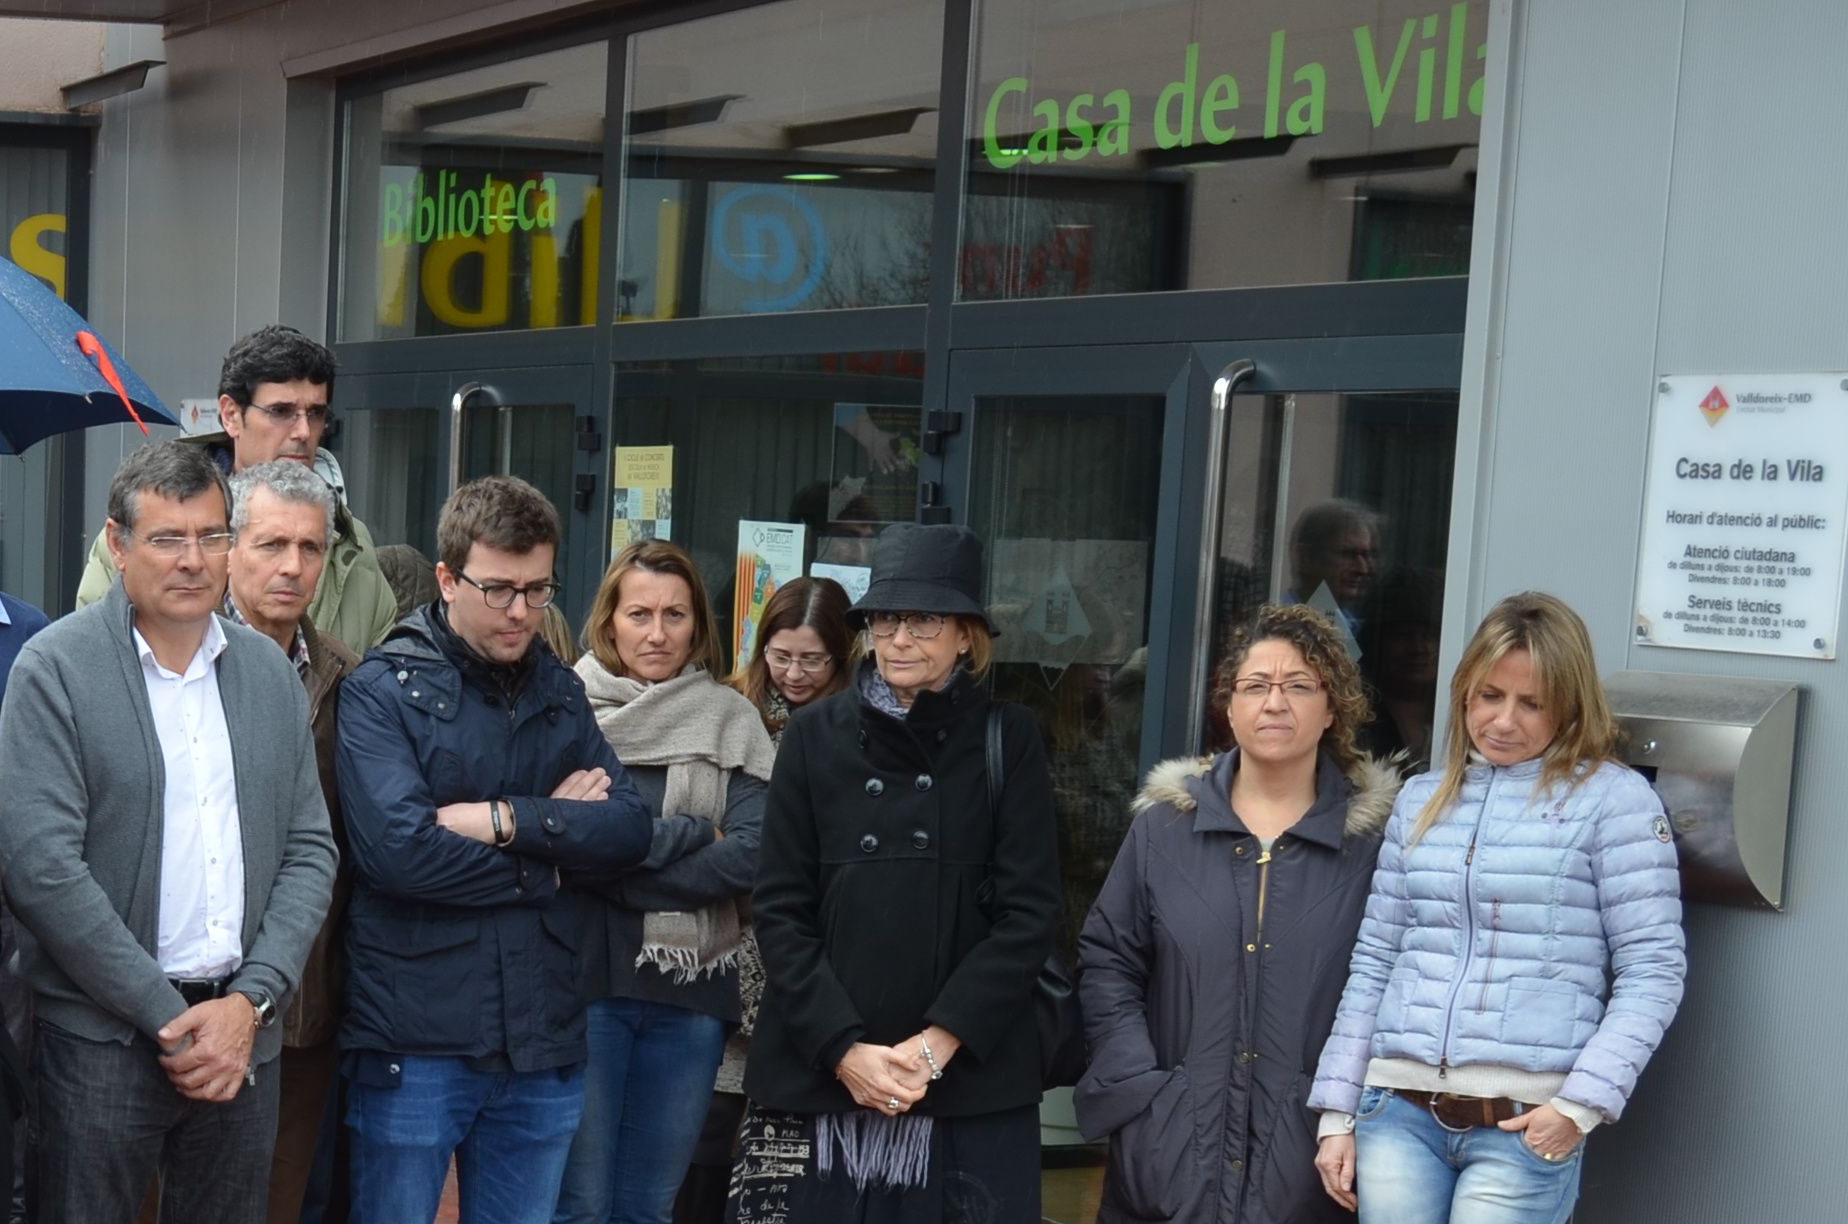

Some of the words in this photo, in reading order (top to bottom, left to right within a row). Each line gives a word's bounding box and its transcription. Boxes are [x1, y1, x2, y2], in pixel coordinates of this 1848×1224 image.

[984, 76, 1131, 169] Casa
[1155, 42, 1239, 150] de
[1264, 29, 1326, 139] la
[382, 168, 558, 249] Biblioteca
[1675, 456, 1723, 480] Casa
[1730, 458, 1754, 481] de
[1761, 458, 1779, 481] la
[1786, 459, 1824, 482] Vila
[1666, 510, 1703, 525] Horari
[1706, 511, 1763, 528] d'atenció
[1766, 514, 1778, 528] al
[1781, 514, 1827, 531] públic:
[1683, 544, 1730, 560] Atenció
[1733, 547, 1796, 563] ciutadana
[1743, 564, 1754, 573] de
[1687, 594, 1733, 611] Serveis
[1737, 597, 1782, 615] tècnics
[1738, 615, 1749, 625] de
